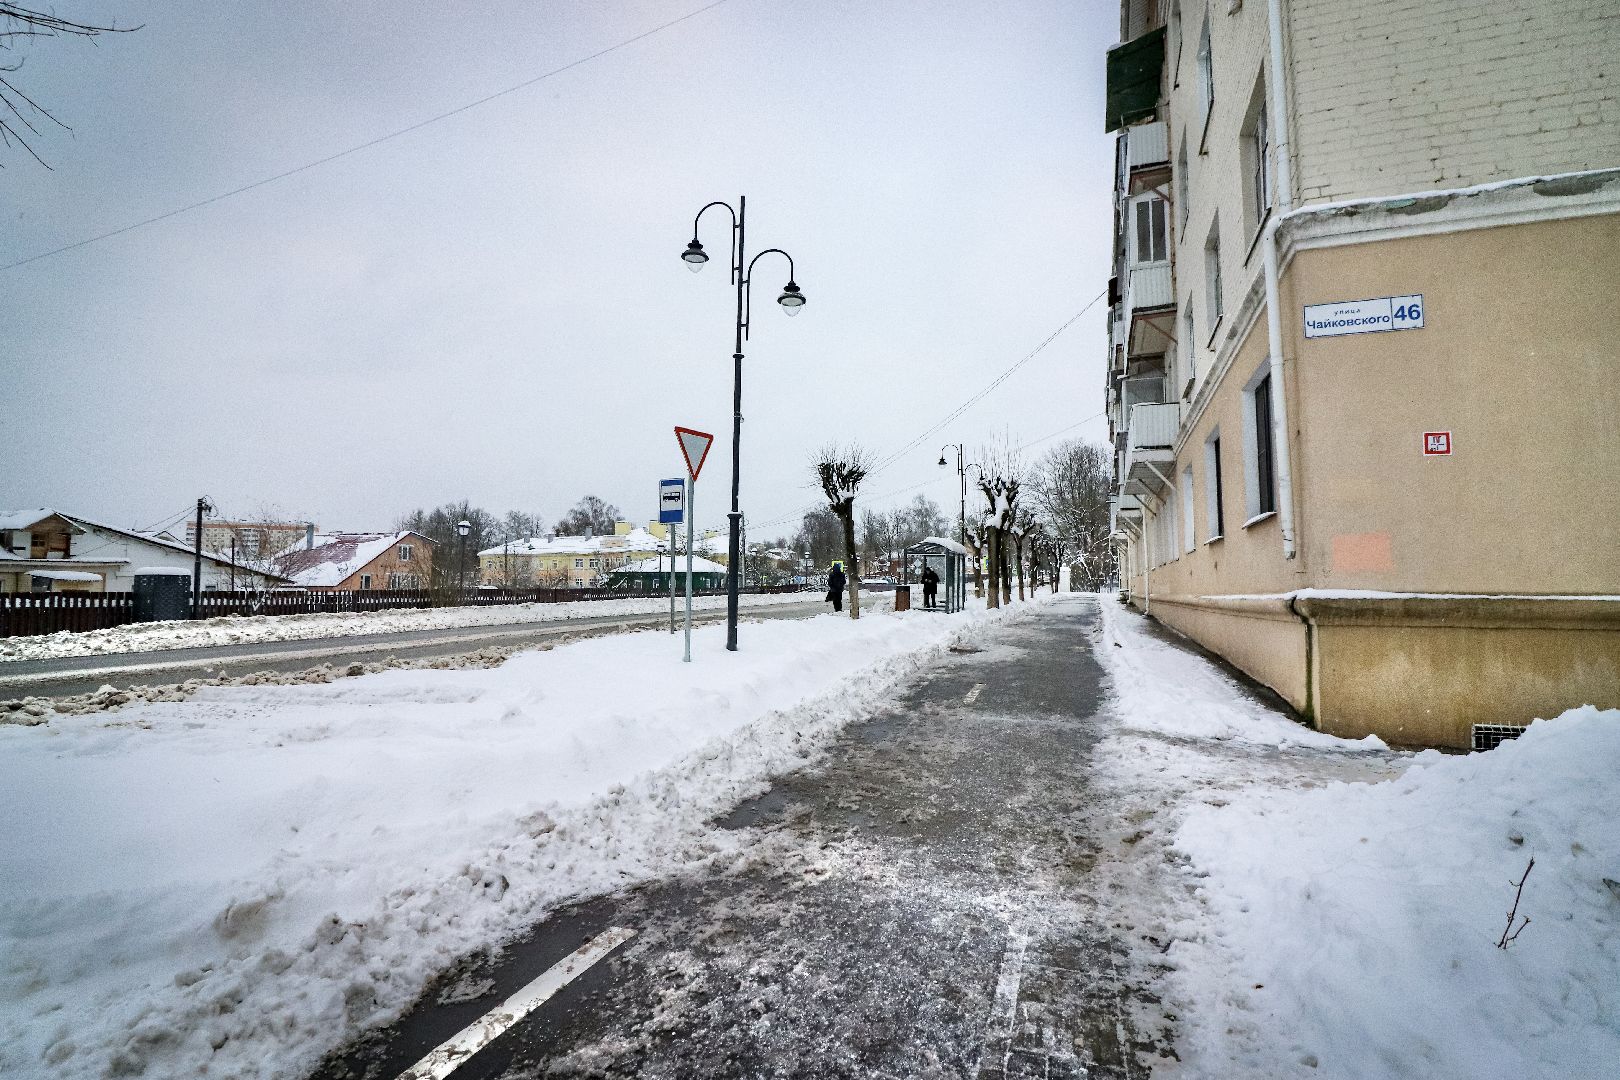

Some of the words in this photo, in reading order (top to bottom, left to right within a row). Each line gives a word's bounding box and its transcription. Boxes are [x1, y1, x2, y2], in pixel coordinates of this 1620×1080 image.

[1306, 315, 1390, 329] Чайковского
[1393, 303, 1421, 321] 46
[1334, 308, 1361, 316] улица
